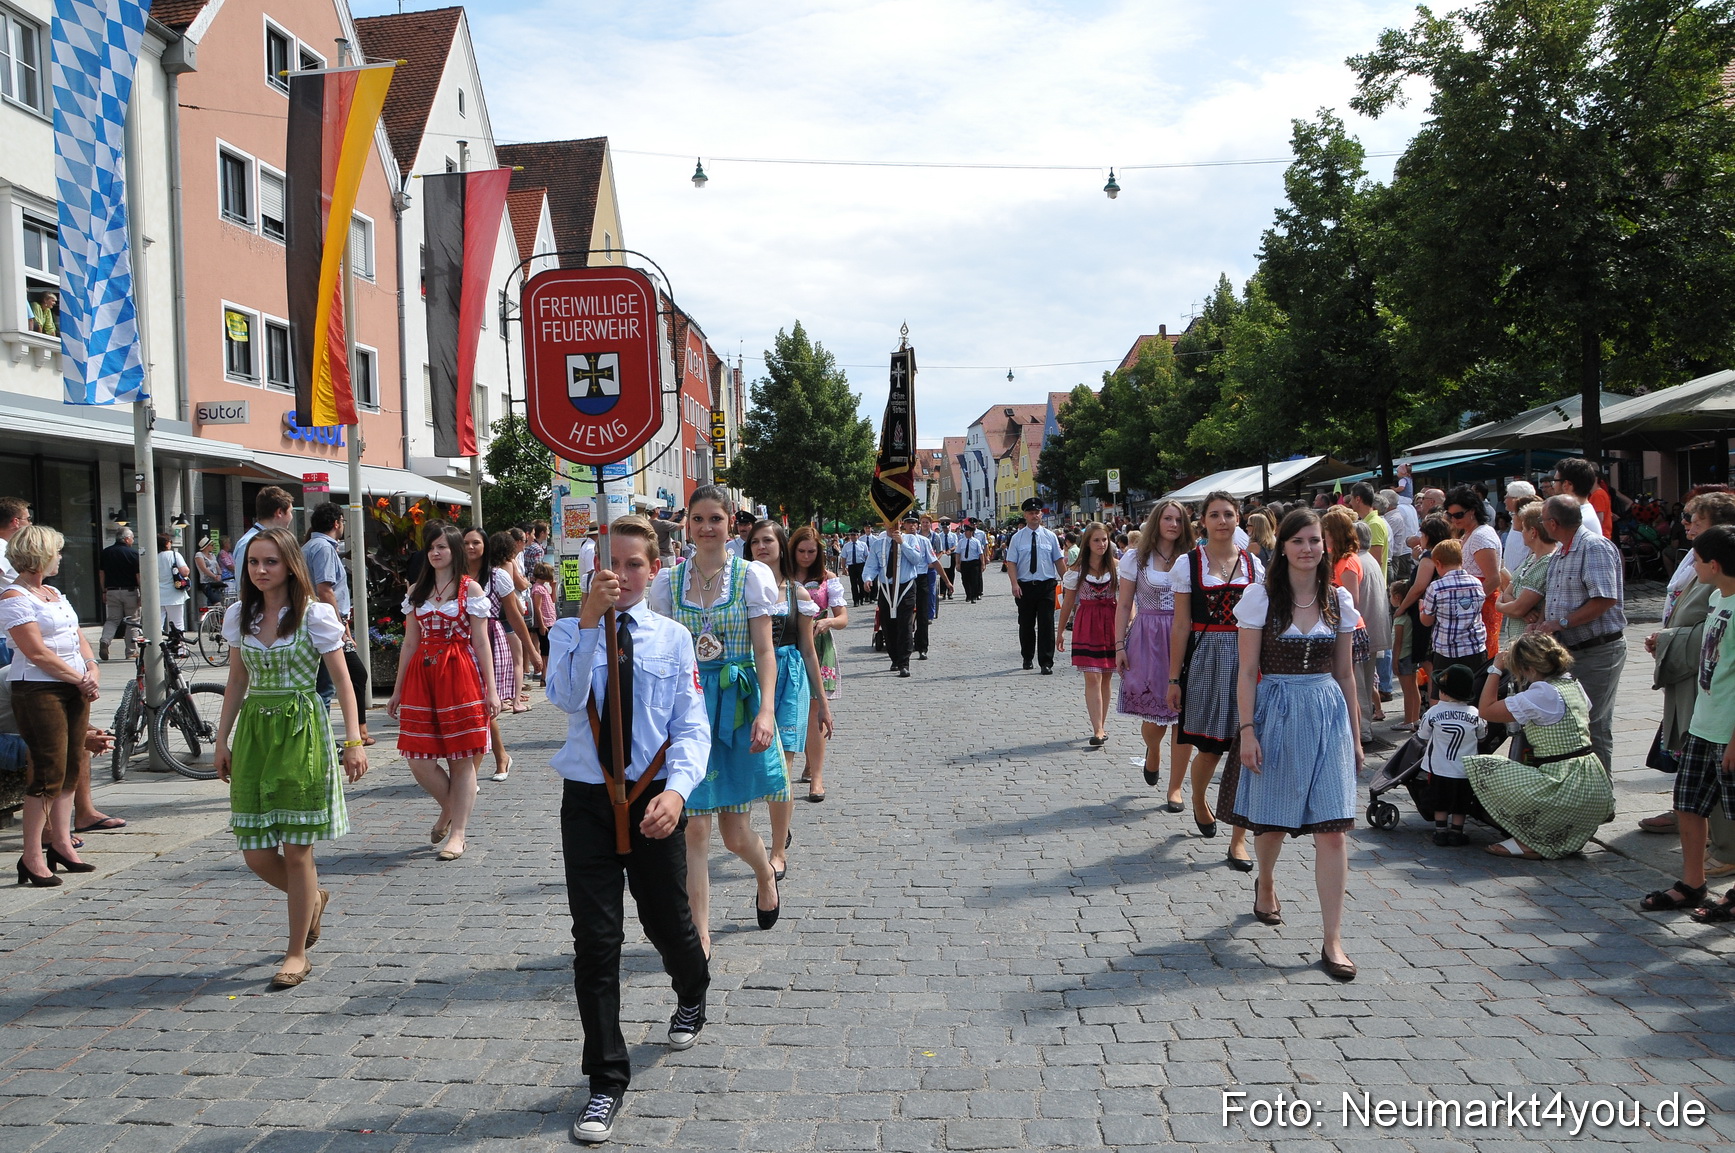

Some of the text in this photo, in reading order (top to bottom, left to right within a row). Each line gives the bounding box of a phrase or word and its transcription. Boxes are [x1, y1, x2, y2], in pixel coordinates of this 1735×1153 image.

[539, 293, 639, 318] FREIWILLIGE
[542, 318, 641, 342] FEUERWEHR
[198, 404, 244, 420] sutor.
[568, 418, 628, 447] HENG
[1441, 724, 1465, 761] 7
